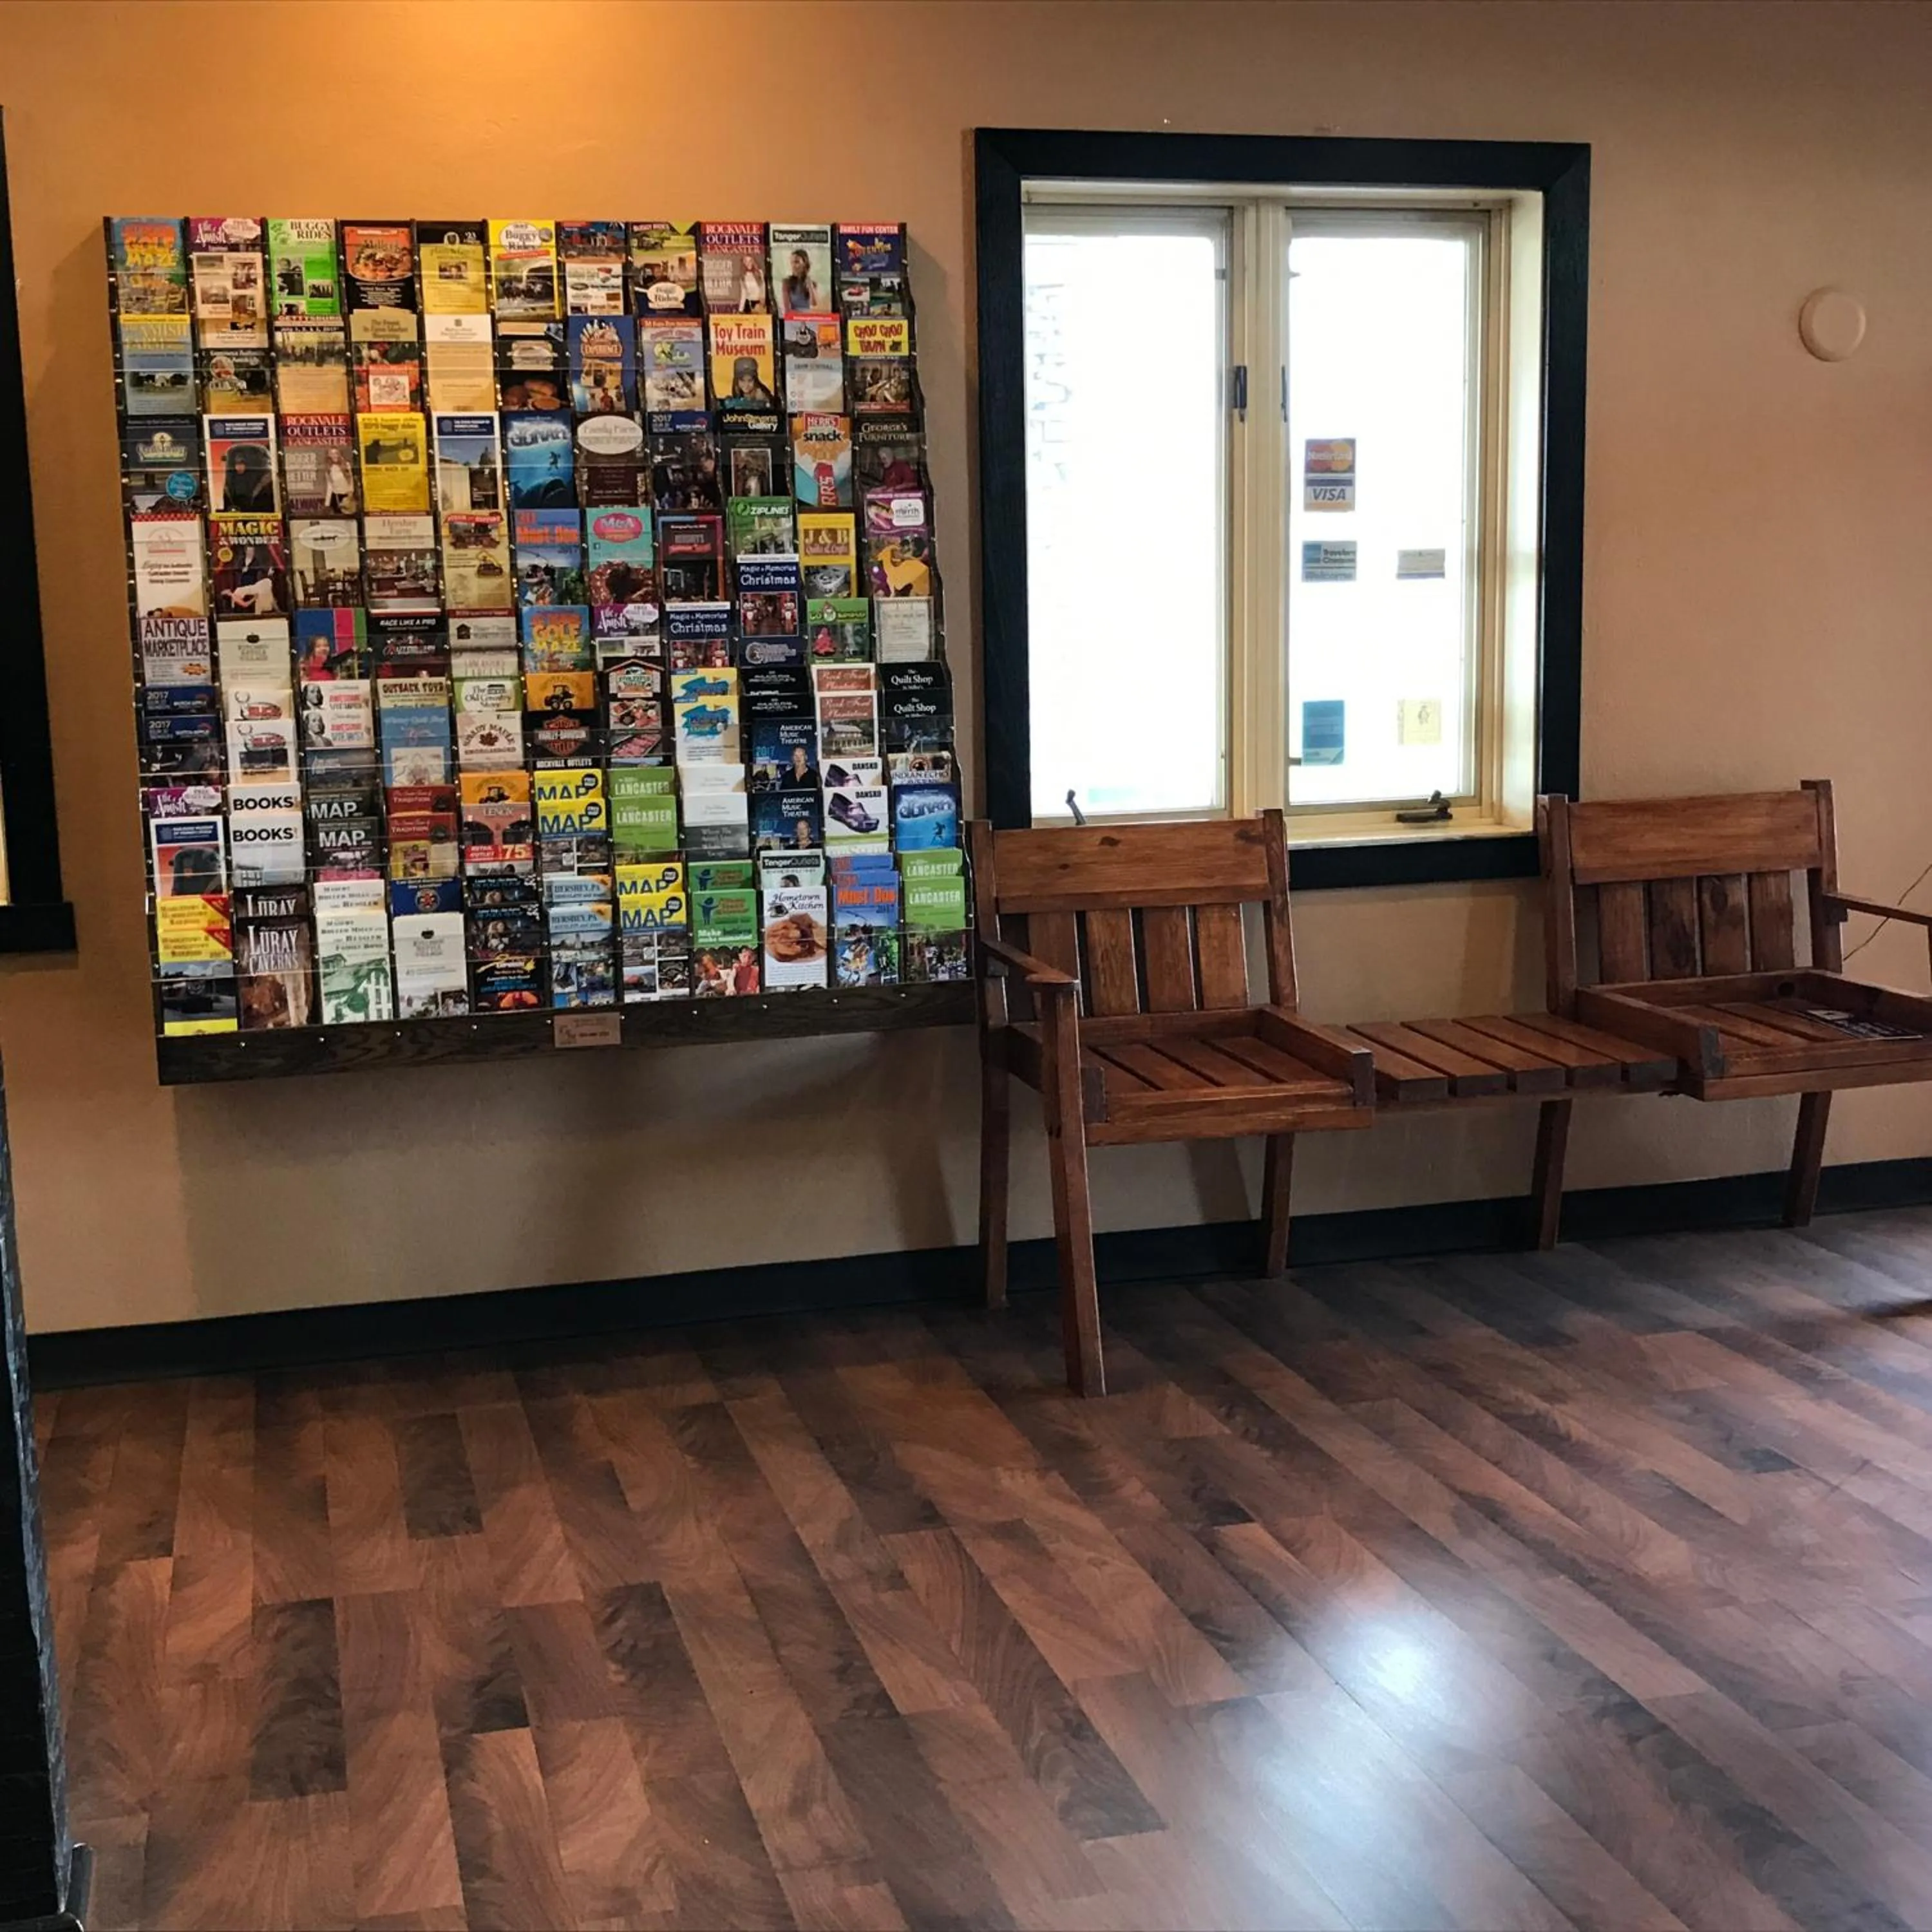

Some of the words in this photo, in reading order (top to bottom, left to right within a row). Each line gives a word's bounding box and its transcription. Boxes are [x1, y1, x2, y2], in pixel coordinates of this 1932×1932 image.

[290, 222, 332, 231] BUGGY
[706, 225, 760, 234] ROCKVALE
[875, 225, 898, 234] CENTER
[296, 231, 332, 239] RIDES
[506, 230, 537, 240] Buggy
[706, 235, 760, 245] OUTLETS
[706, 245, 761, 254] LANCASTER
[713, 324, 737, 343] Toy
[738, 324, 765, 338] Train
[853, 325, 876, 337] CHOO
[880, 324, 903, 336] CHOO
[715, 341, 766, 355] Museum
[287, 416, 346, 426] ROCKVALE
[748, 422, 778, 431] Gallery
[861, 422, 908, 433] GEORGE'S
[287, 426, 346, 437] OUTLETS
[803, 429, 842, 442] snack
[288, 437, 348, 446] LANCASTER
[1312, 488, 1347, 501] VISA
[218, 522, 279, 535] MAGIC
[230, 536, 279, 545] WONDER
[804, 530, 814, 544] J
[819, 529, 833, 544] &
[837, 529, 849, 544] B
[741, 574, 796, 585] Christmas
[144, 619, 207, 638] ANTIQUE
[533, 625, 580, 639] GOLF
[670, 621, 727, 633] Christmas
[144, 638, 209, 657] MARKETPLACE
[533, 640, 582, 653] MAZE
[891, 675, 913, 686] Quilt
[913, 676, 933, 686] Shop
[382, 683, 420, 694] OUTBACK
[422, 681, 444, 692] TOYS
[893, 703, 916, 714] Quilt
[916, 703, 937, 714] Shop
[567, 758, 592, 767] OUTLETS
[852, 762, 878, 771] DANSKO
[537, 786, 587, 800] MAP
[616, 781, 670, 795] LANCASTER
[855, 790, 882, 799] DANSKO
[311, 802, 357, 820] MAP
[617, 810, 672, 824] LANCASTER
[541, 814, 592, 833] MAP
[319, 830, 366, 848] MAP
[502, 846, 527, 860] 75
[907, 864, 958, 876] LANCASTER
[619, 878, 667, 895] MAP
[773, 893, 820, 904] Hometown
[909, 891, 961, 904] LANCASTER
[245, 894, 297, 918] LURAY
[790, 902, 825, 911] Kitchen
[622, 908, 674, 929] MAP
[247, 925, 298, 956] LURAY
[249, 951, 299, 976] CAVERNS
